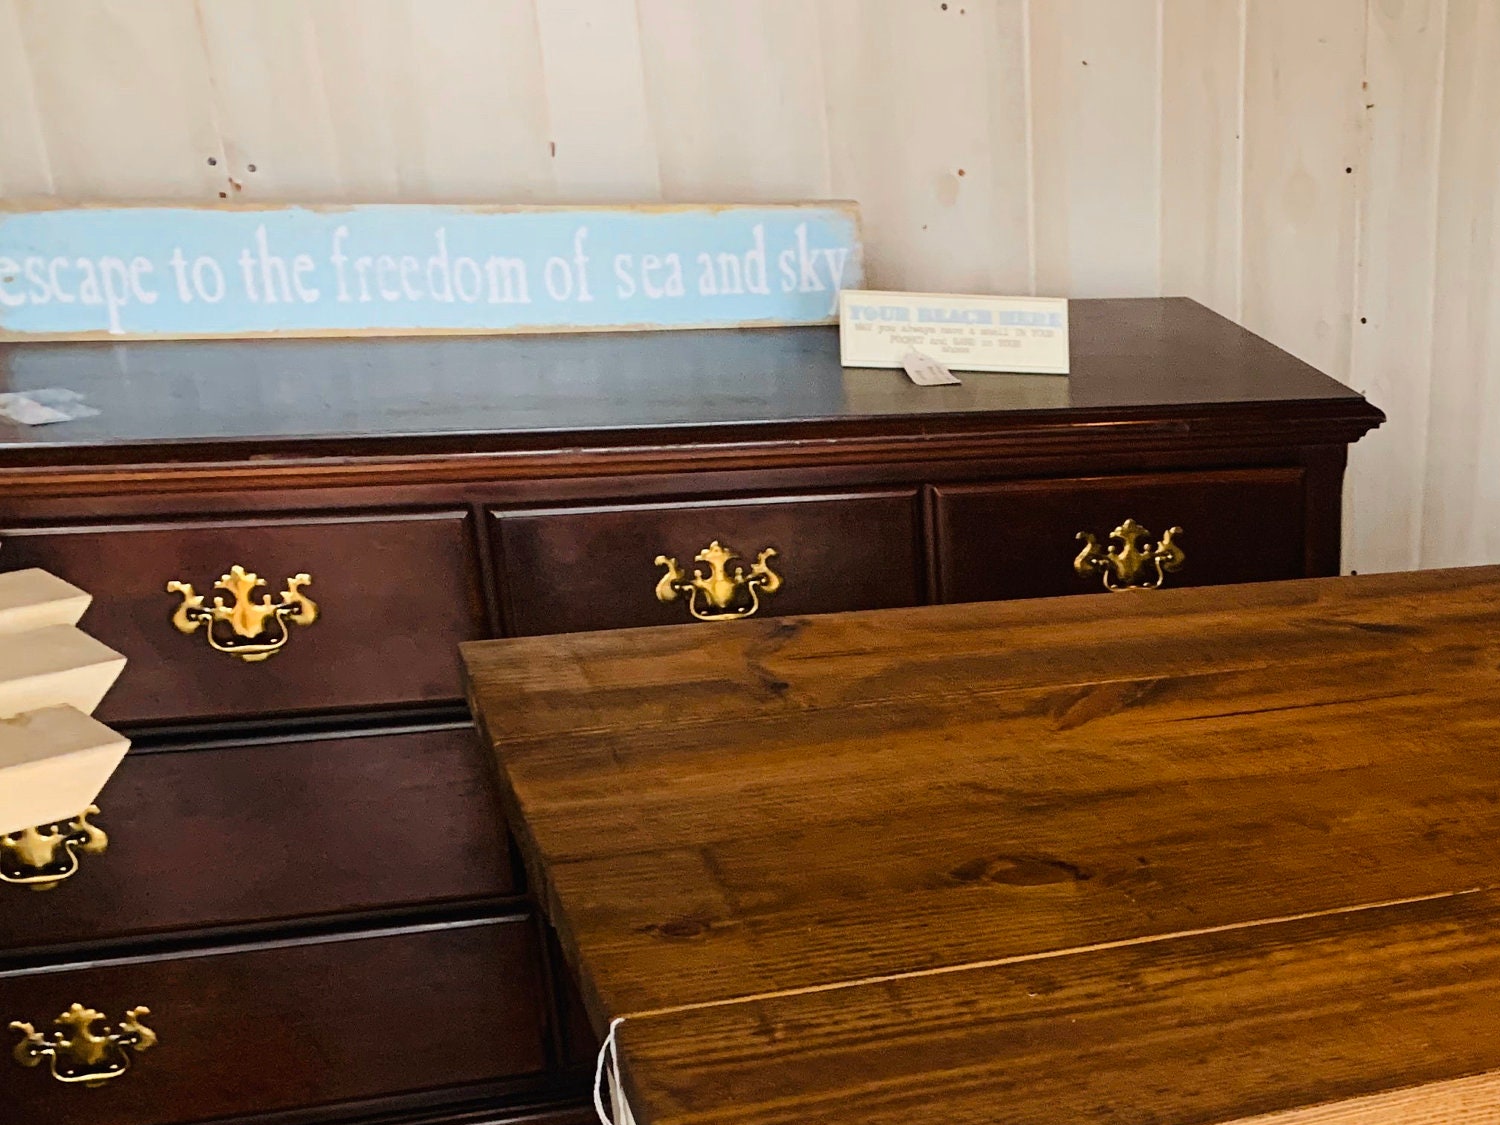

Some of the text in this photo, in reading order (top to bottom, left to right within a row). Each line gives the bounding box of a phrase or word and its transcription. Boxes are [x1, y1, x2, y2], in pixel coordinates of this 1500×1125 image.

[0, 221, 849, 335] escape to the freedom of sea and sky
[849, 304, 910, 322] YOUR
